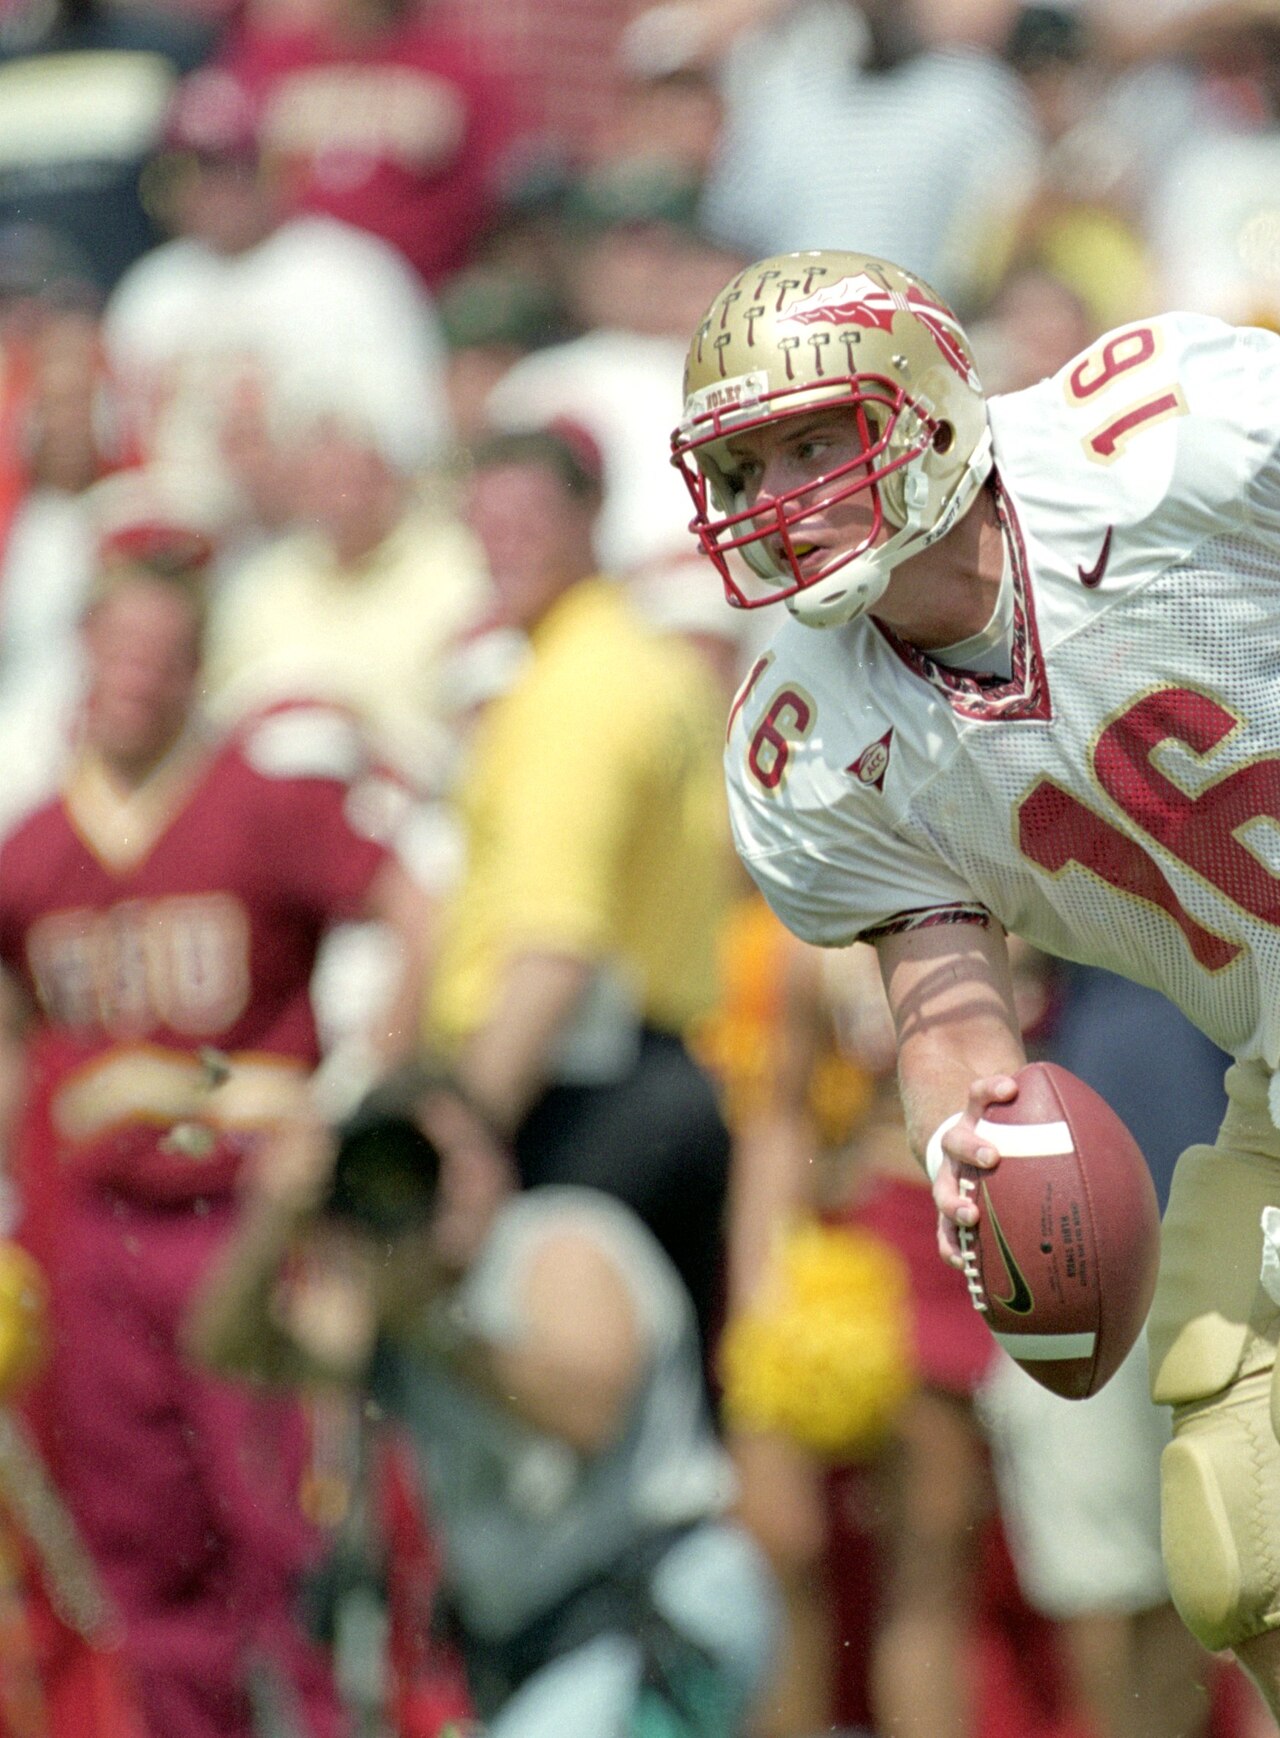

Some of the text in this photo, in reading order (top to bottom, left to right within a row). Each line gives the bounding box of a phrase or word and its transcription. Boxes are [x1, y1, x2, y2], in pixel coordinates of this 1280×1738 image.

[1064, 324, 1190, 467] 16
[727, 650, 818, 799] 16
[867, 753, 885, 777] ACC
